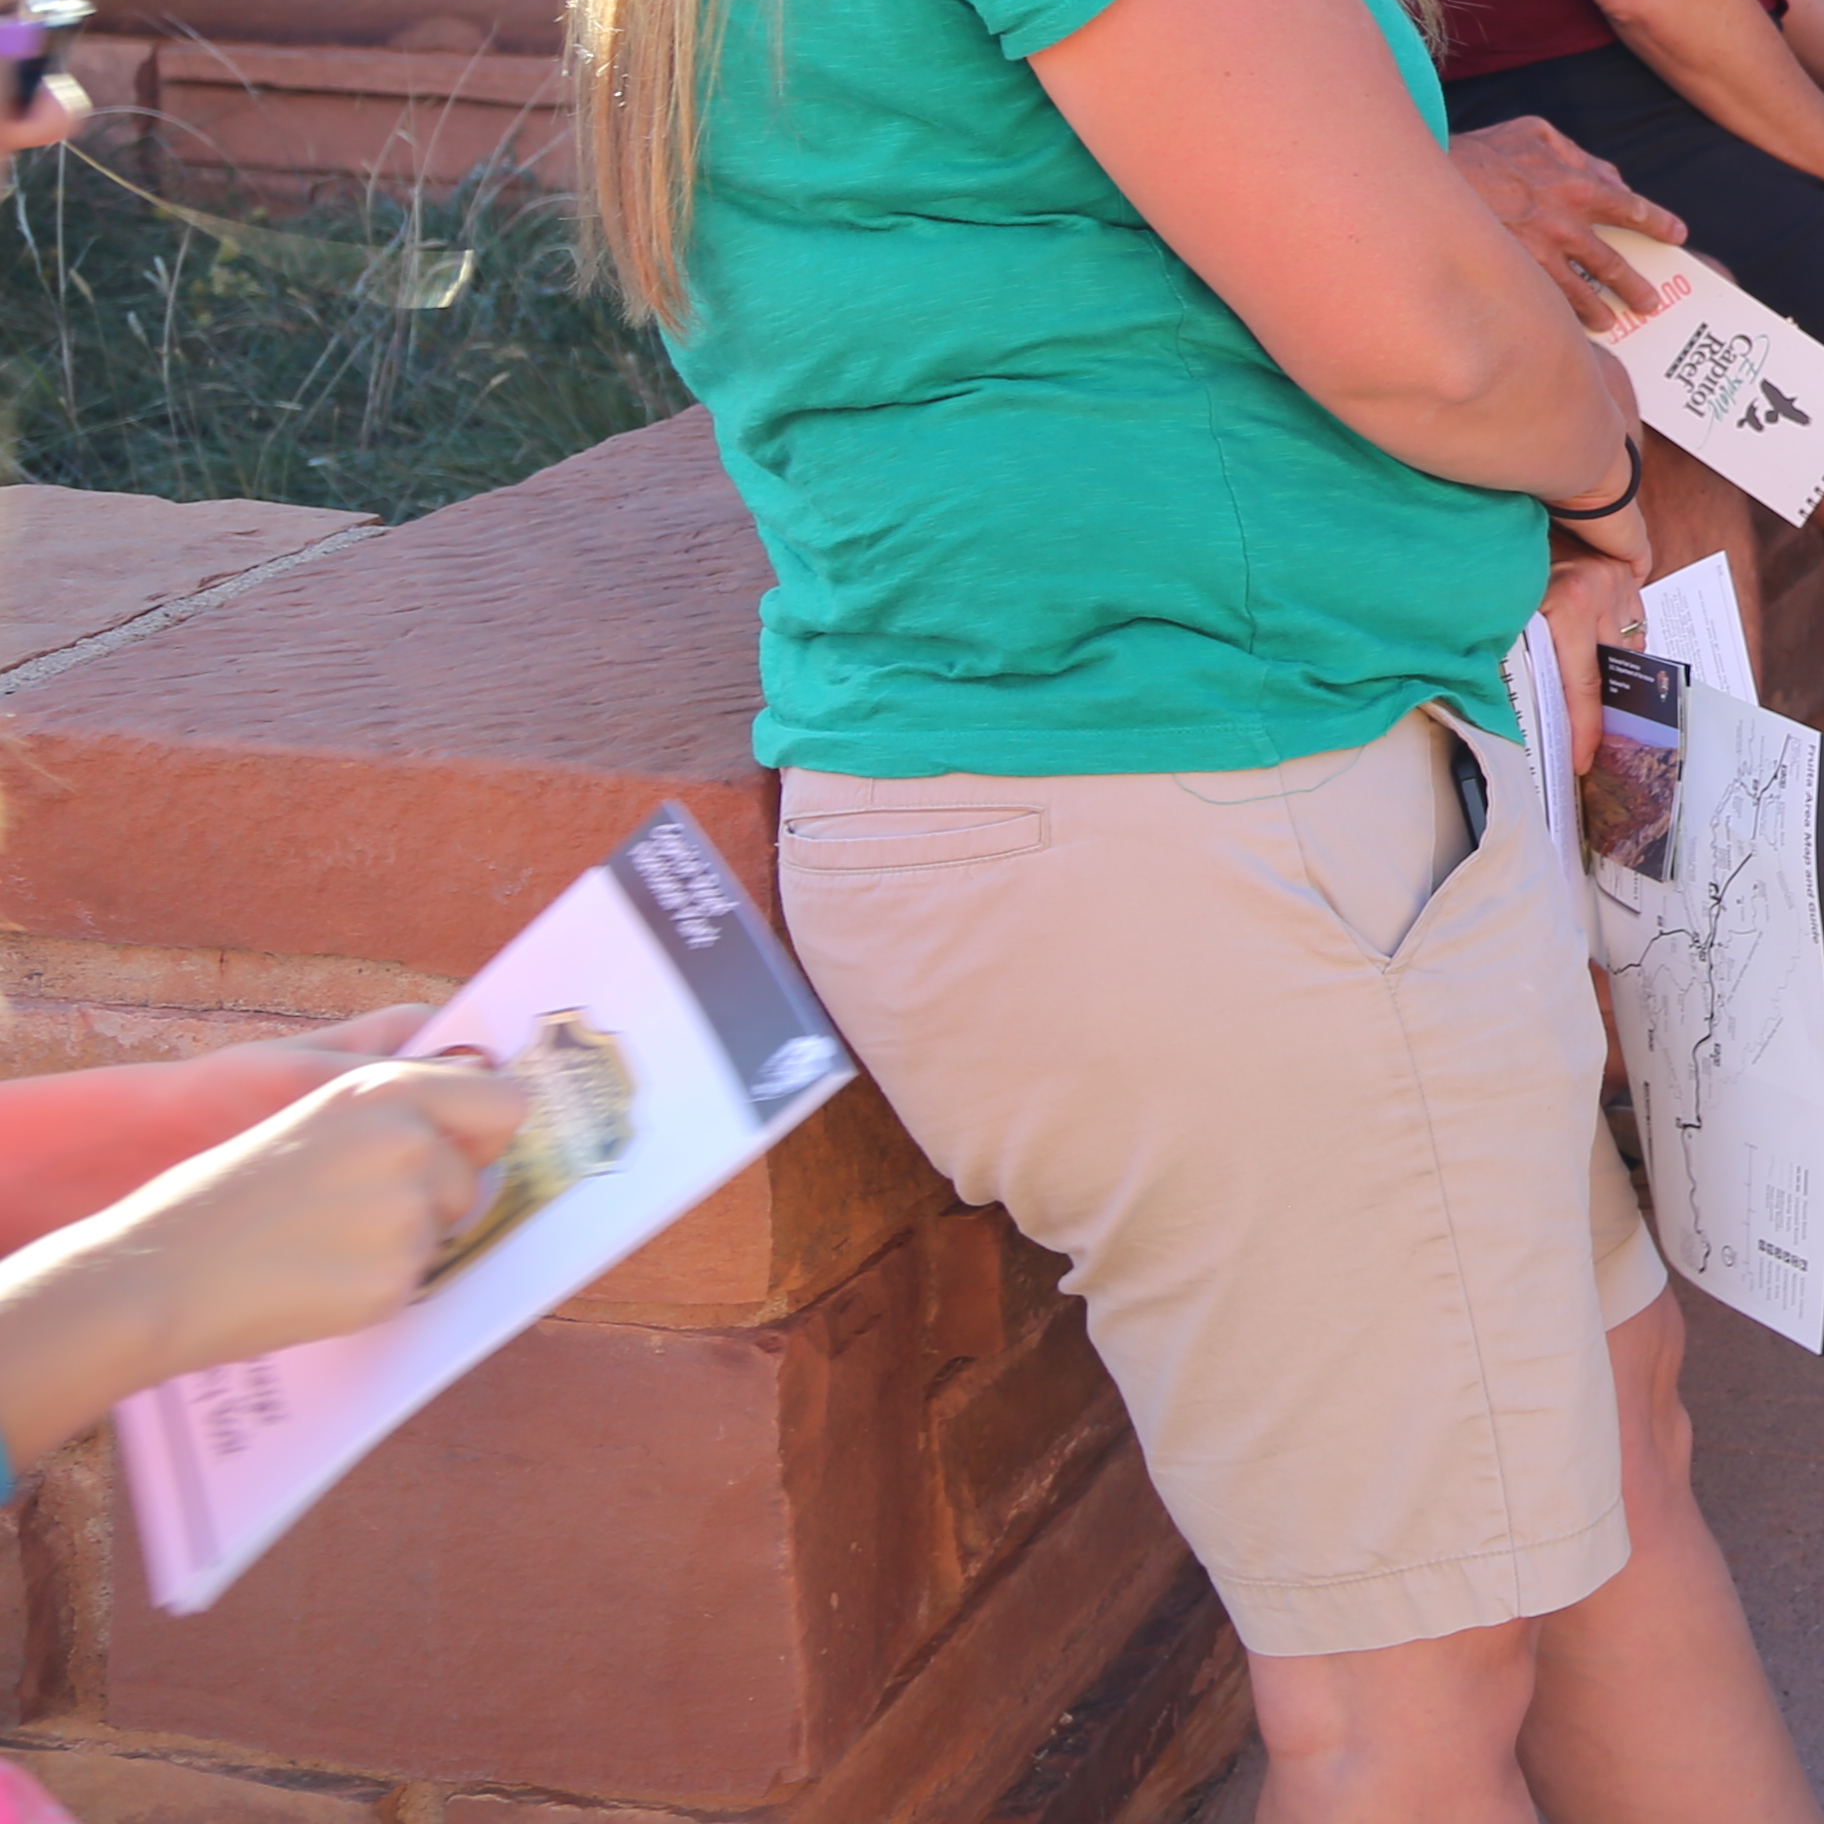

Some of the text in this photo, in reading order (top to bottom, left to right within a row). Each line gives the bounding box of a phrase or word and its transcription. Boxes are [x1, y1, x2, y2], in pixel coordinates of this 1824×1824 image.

[1674, 330, 1726, 394] Reef
[1683, 333, 1754, 420] Capitol
[1801, 744, 1821, 945] Fruita Area Map and Guide
